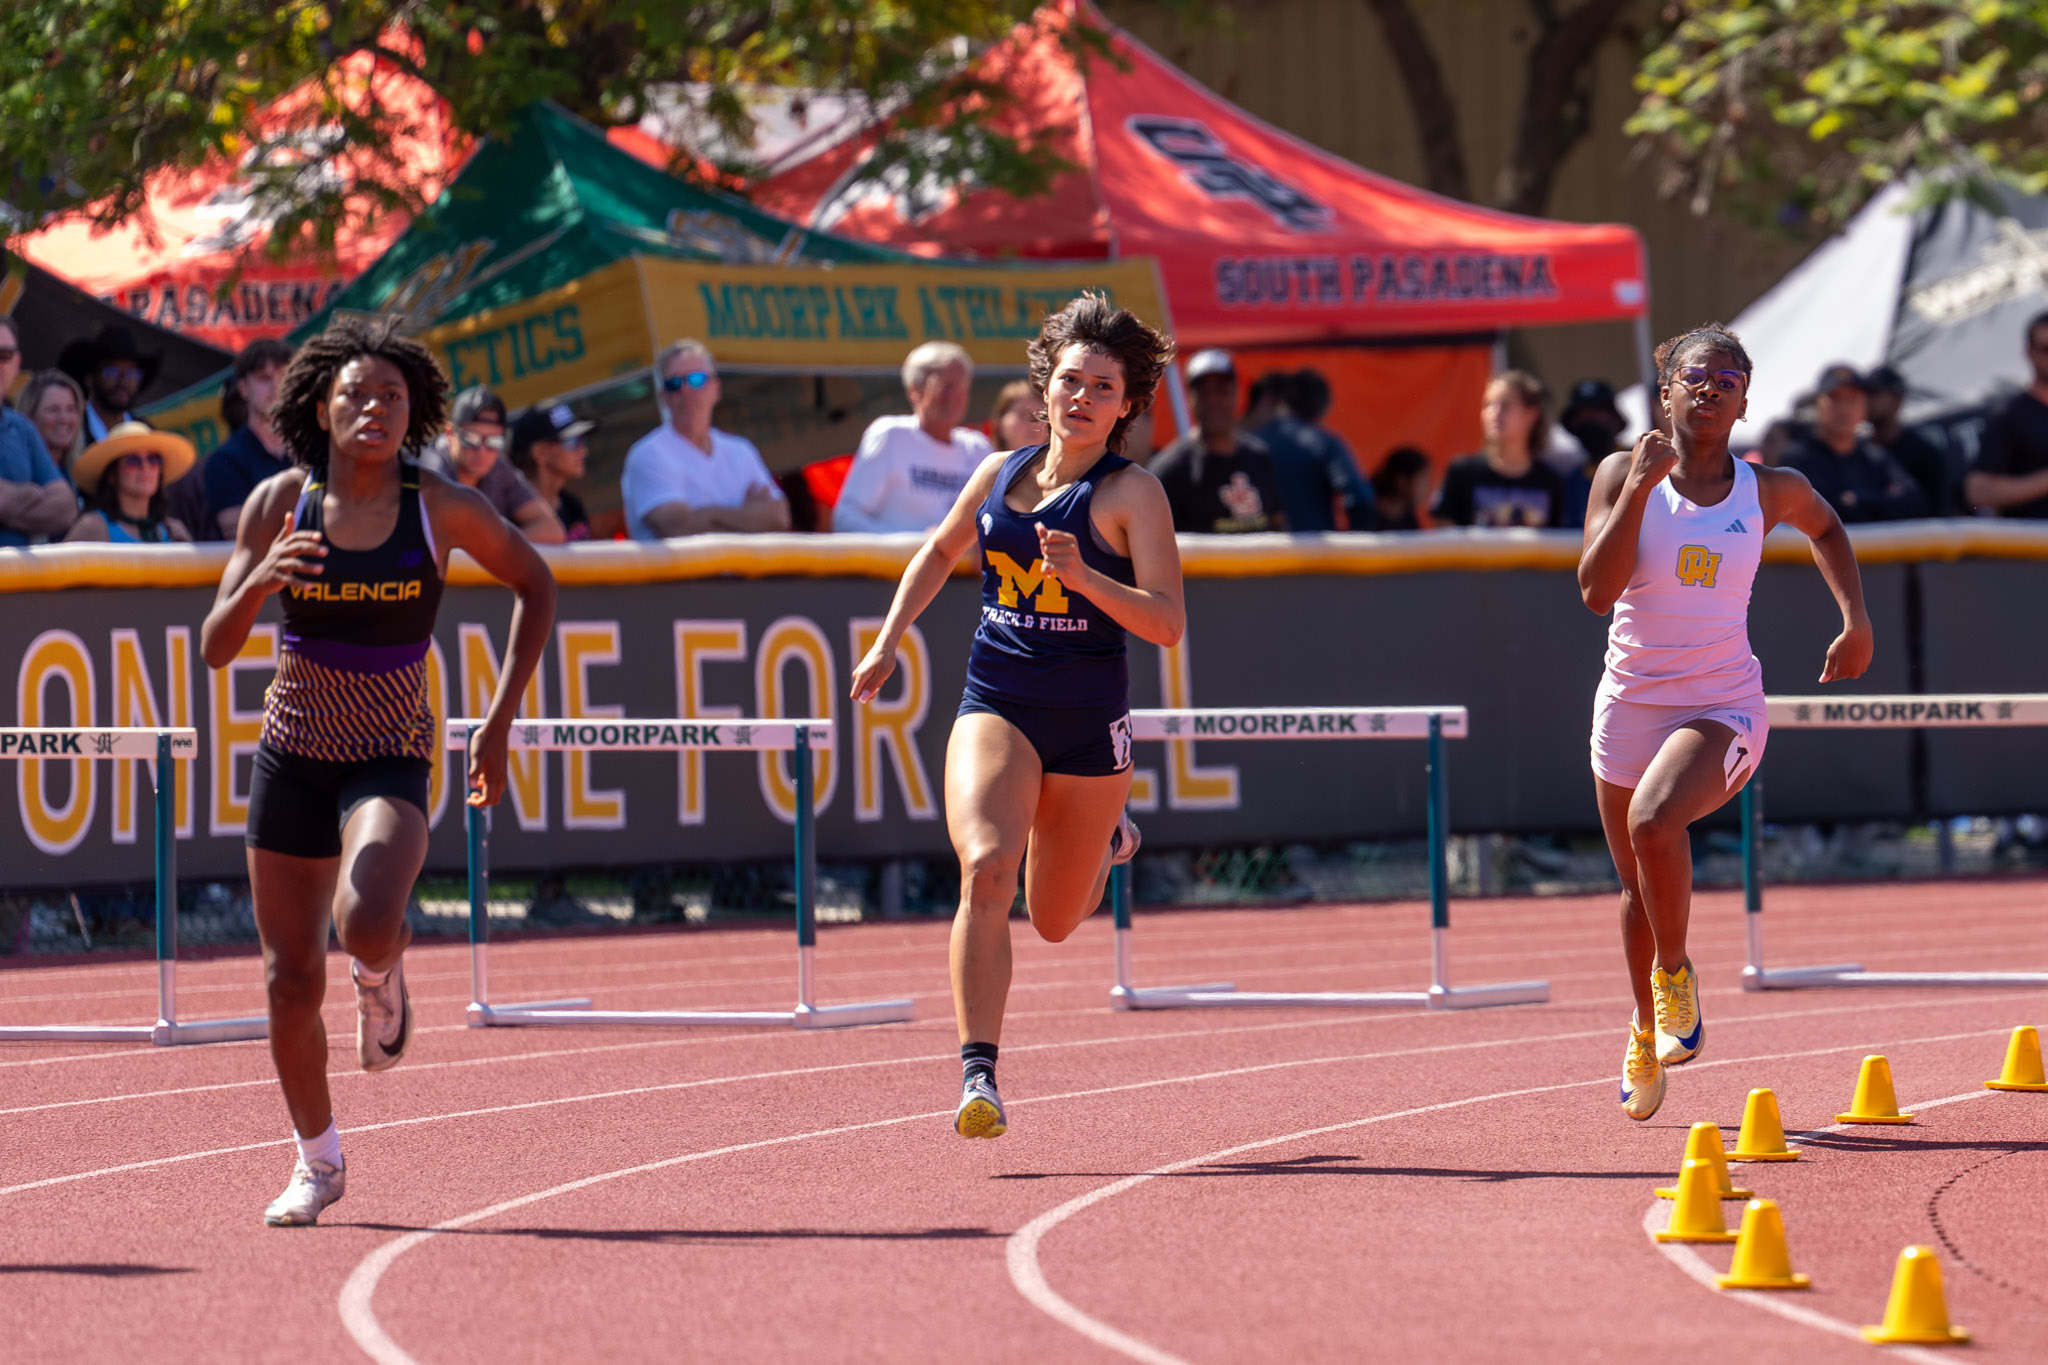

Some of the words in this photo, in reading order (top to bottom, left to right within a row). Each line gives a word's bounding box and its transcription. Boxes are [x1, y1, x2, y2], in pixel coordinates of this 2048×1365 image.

[1216, 256, 1343, 304] SOUTH
[1352, 252, 1557, 302] PASADENA
[698, 281, 910, 341] MOORPARK
[290, 580, 422, 601] VALENCIA
[985, 549, 1069, 614] M
[982, 606, 1020, 628] TRACK
[1024, 615, 1034, 629] &
[1040, 616, 1088, 631] FIELD
[1824, 702, 1984, 721] MOORPARK
[17, 622, 281, 856] ONE
[429, 619, 627, 832] NE
[673, 615, 938, 826] FOR
[553, 725, 721, 746] MOORPARK
[1193, 713, 1357, 735] MOORPARK
[1, 732, 82, 754] PARK
